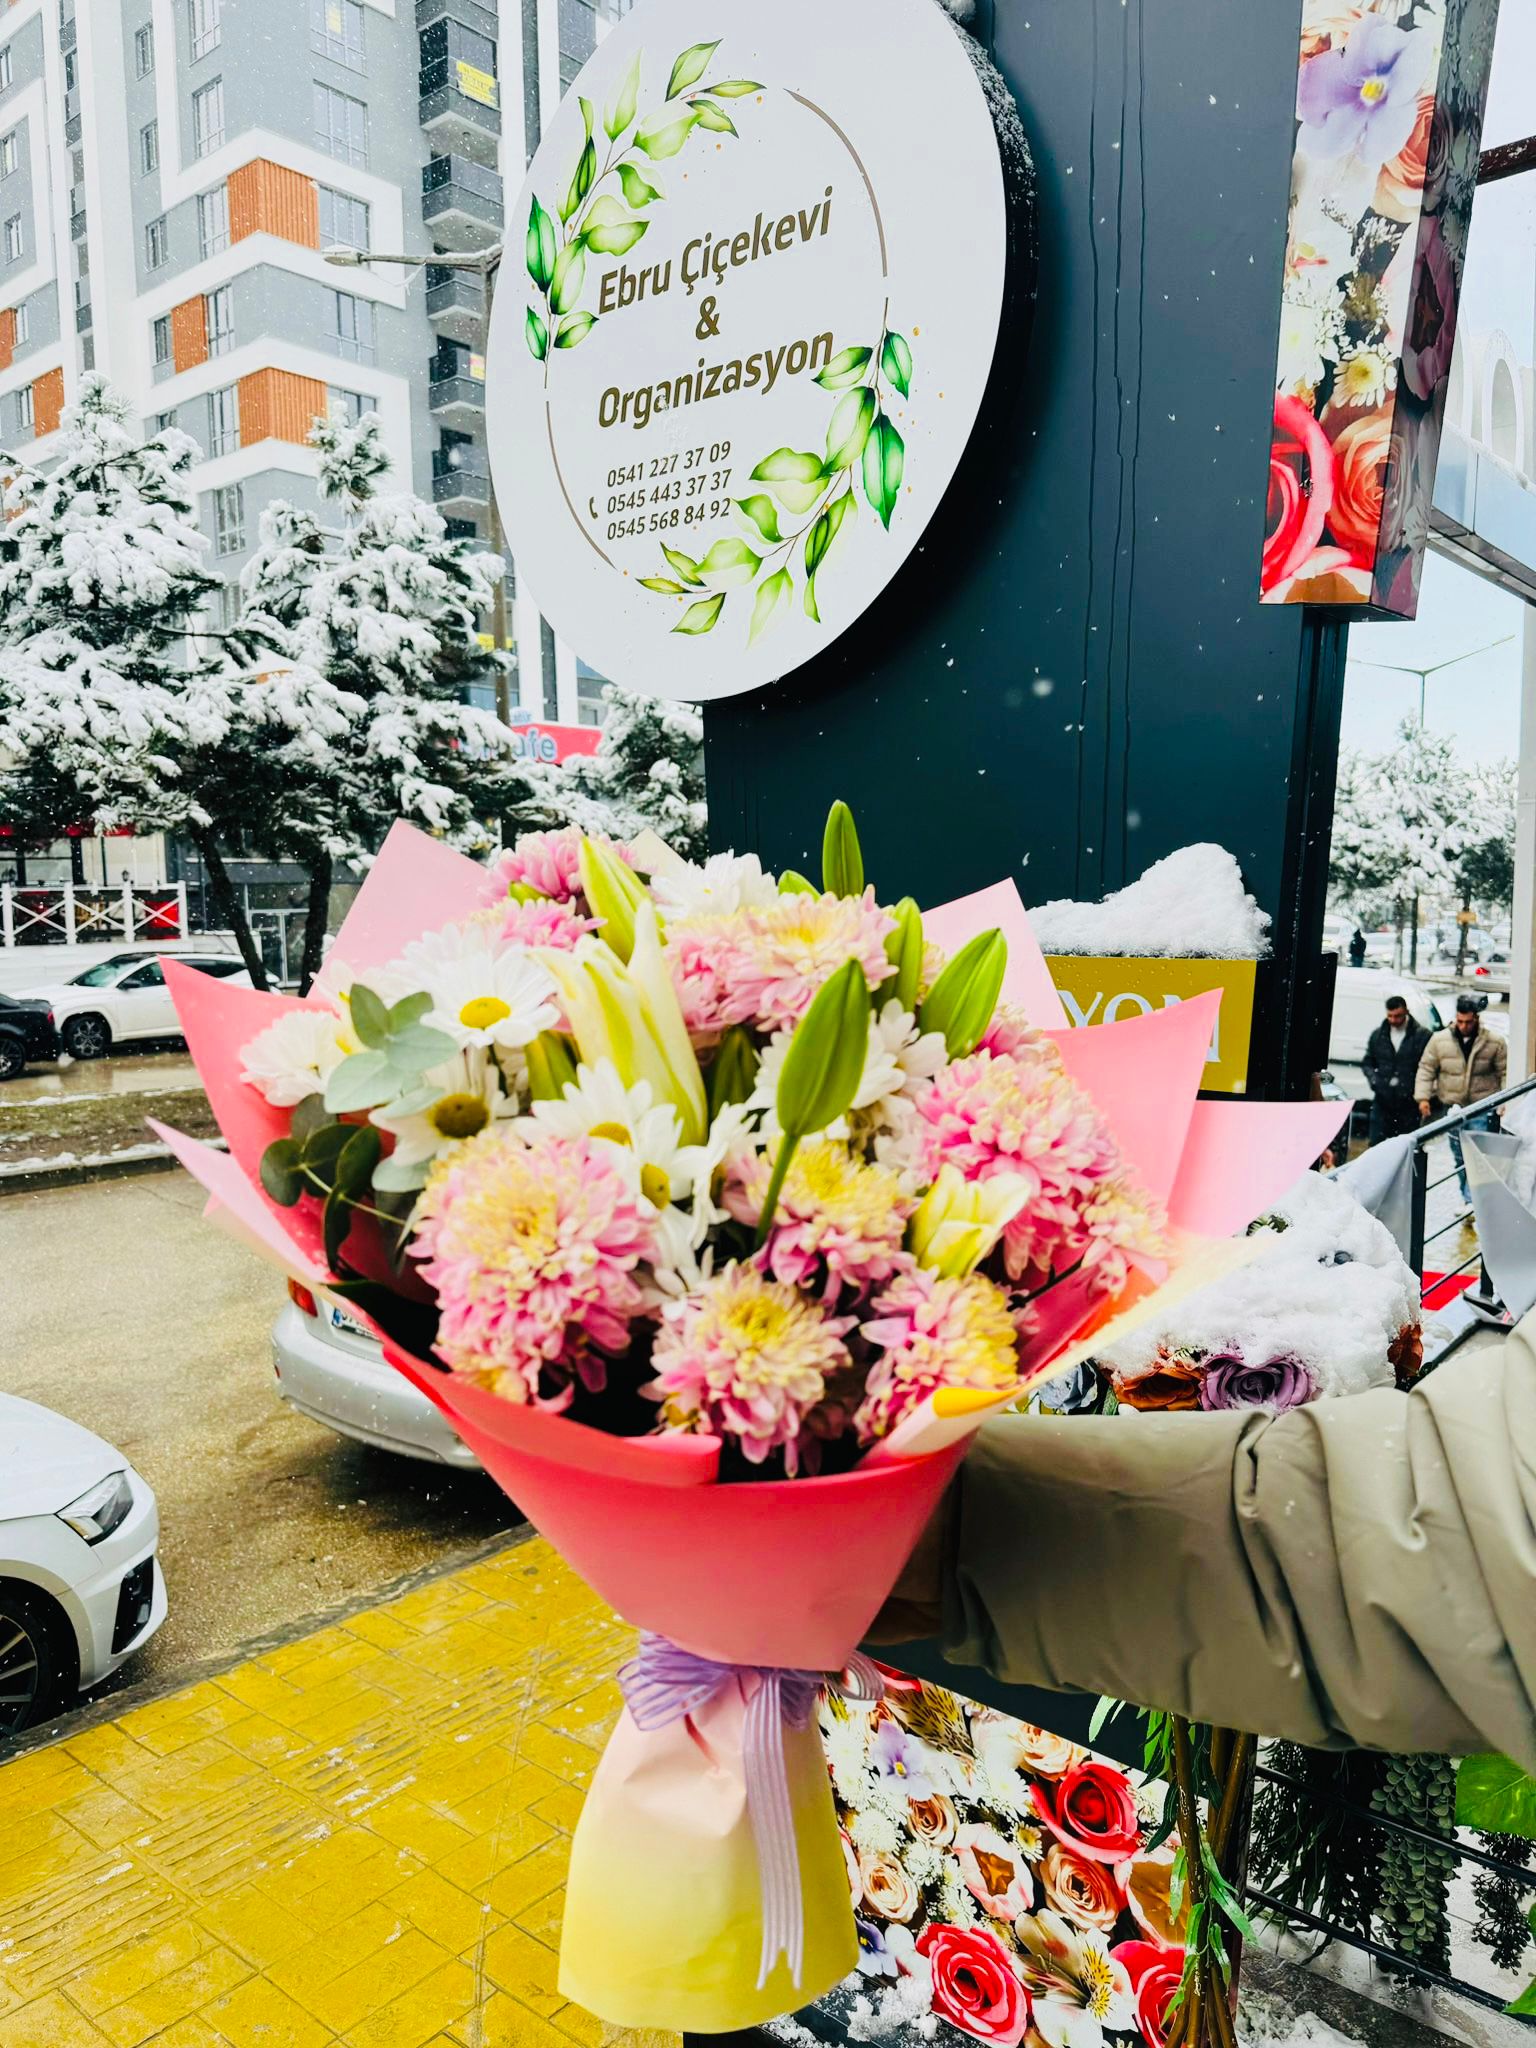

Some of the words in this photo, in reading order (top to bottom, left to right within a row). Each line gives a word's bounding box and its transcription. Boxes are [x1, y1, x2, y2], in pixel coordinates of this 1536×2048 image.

[598, 259, 672, 315] Ebru
[680, 185, 833, 297] Çiçekevi
[695, 295, 721, 341] &
[598, 330, 834, 430] Organizasyon
[607, 462, 644, 488] 0541
[648, 453, 679, 479] 227
[683, 446, 705, 470] 37
[709, 440, 731, 464] 09
[607, 488, 646, 515] 0545
[649, 480, 682, 505] 443
[685, 474, 708, 497] 37
[710, 468, 733, 491] 37
[607, 515, 646, 541] 0545
[648, 508, 680, 532] 568
[683, 502, 706, 525] 84
[709, 496, 731, 520] 92
